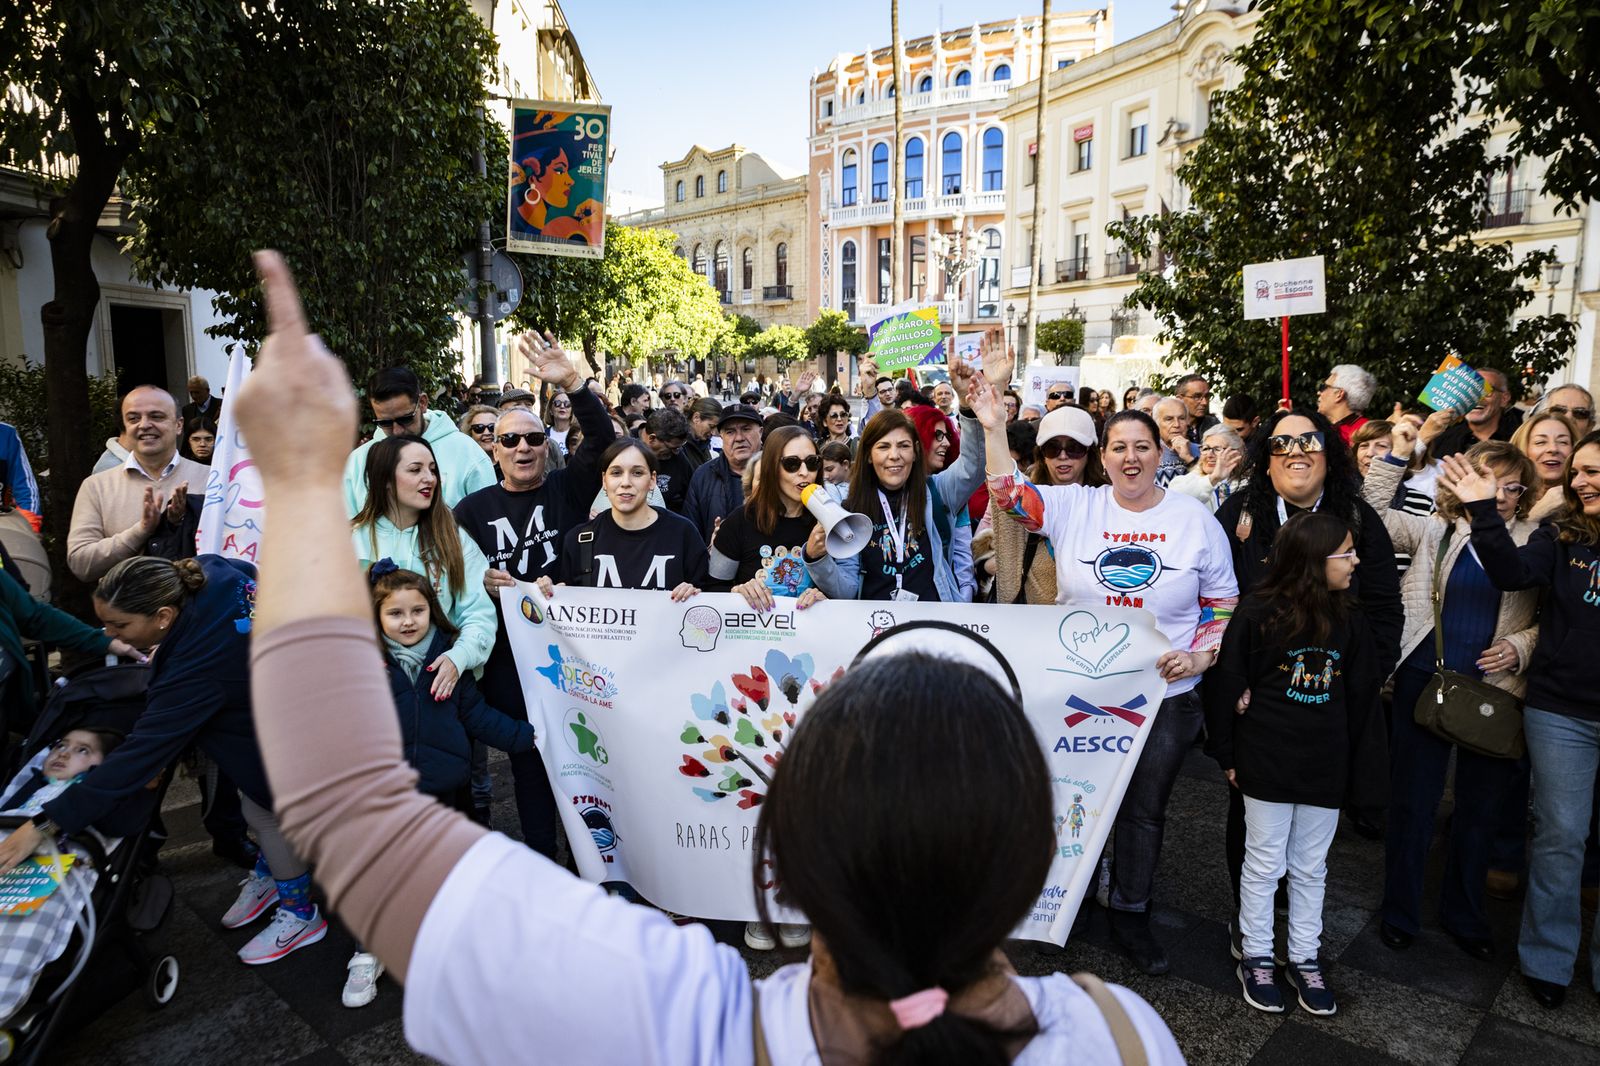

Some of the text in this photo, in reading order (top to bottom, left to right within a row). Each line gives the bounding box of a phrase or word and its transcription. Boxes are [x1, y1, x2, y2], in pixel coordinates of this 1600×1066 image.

[574, 115, 604, 140] 30
[588, 143, 603, 152] FES
[582, 150, 603, 159] TIVAL
[591, 159, 603, 167] DE
[577, 165, 603, 175] JEREZ
[1273, 279, 1313, 288] Duchenne
[1284, 285, 1313, 294] España
[899, 319, 923, 330] RARO
[873, 328, 933, 347] MARAVILLOSO
[879, 346, 899, 356] cada
[900, 341, 935, 353] persona
[534, 529, 559, 542] X-Men
[1103, 531, 1166, 543] SYNGAP1
[1106, 595, 1144, 608] IVAN
[546, 604, 637, 626] ANSEDH
[725, 610, 796, 630] aevel
[575, 626, 603, 634] NACIONAL
[1066, 654, 1076, 662] UN
[1076, 661, 1093, 673] GRITO
[1106, 642, 1131, 665] ESPERANZA
[564, 665, 606, 691] DIEGO
[1286, 687, 1330, 704] UNIPER
[599, 699, 613, 709] AME
[1053, 735, 1134, 753] AESCO
[676, 822, 731, 850] RARAS
